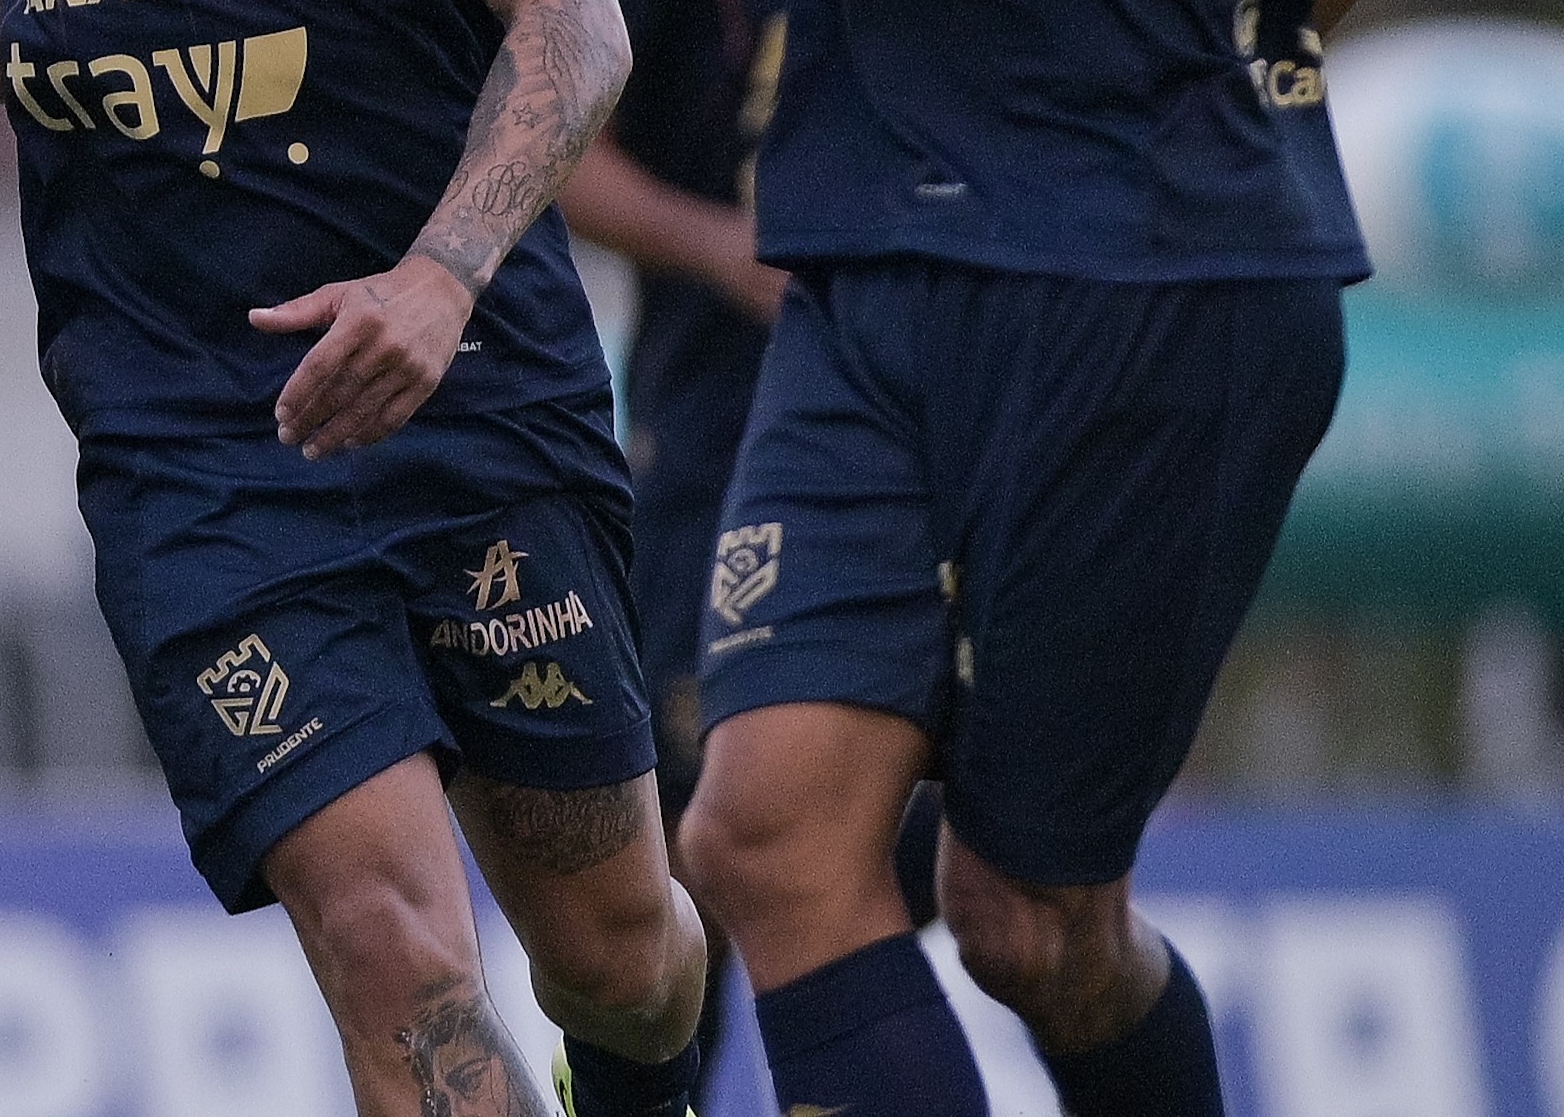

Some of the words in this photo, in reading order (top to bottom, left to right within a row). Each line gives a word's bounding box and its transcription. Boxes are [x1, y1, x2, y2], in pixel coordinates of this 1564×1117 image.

[6, 39, 237, 156] tray
[431, 590, 594, 657] ANDORINHA
[256, 716, 324, 773] PRUDENTE
